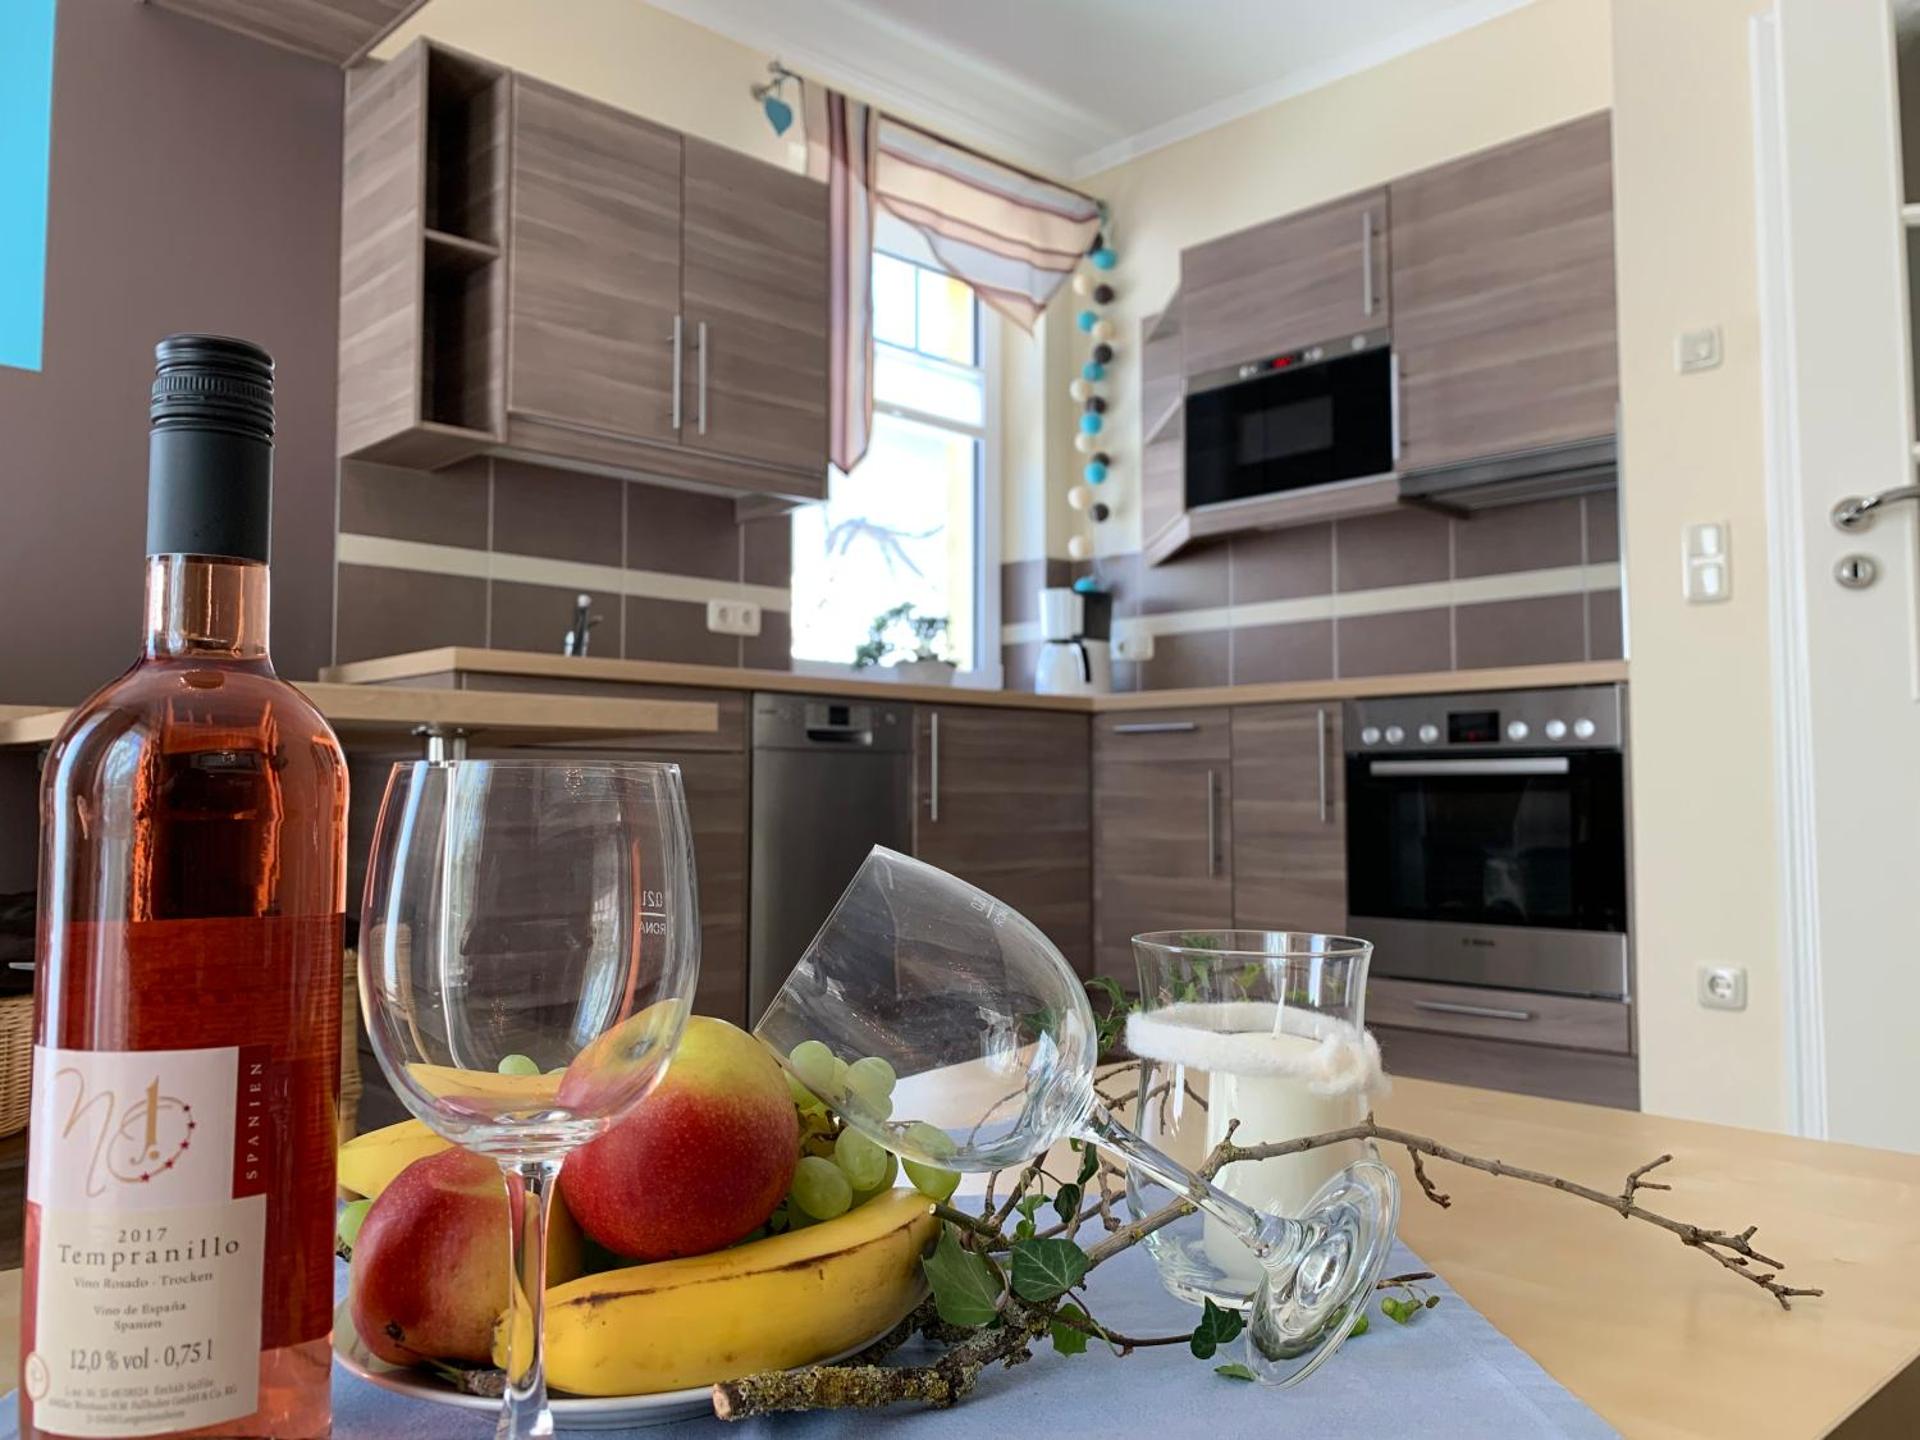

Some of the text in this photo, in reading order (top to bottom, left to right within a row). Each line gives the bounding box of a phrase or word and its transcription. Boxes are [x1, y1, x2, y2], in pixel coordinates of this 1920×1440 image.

[245, 1064, 262, 1180] SPANIEN
[118, 1227, 167, 1244] 2017
[58, 1236, 240, 1272] Tempranillo
[73, 1277, 99, 1288] Vino
[103, 1277, 149, 1289] Rosado
[159, 1271, 214, 1286] Trocken
[94, 1301, 187, 1316] Vino de España
[114, 1319, 162, 1333] Spanien
[70, 1349, 101, 1372] 12,0
[105, 1350, 119, 1370] %
[122, 1347, 149, 1370] vol
[164, 1341, 202, 1370] 0,75
